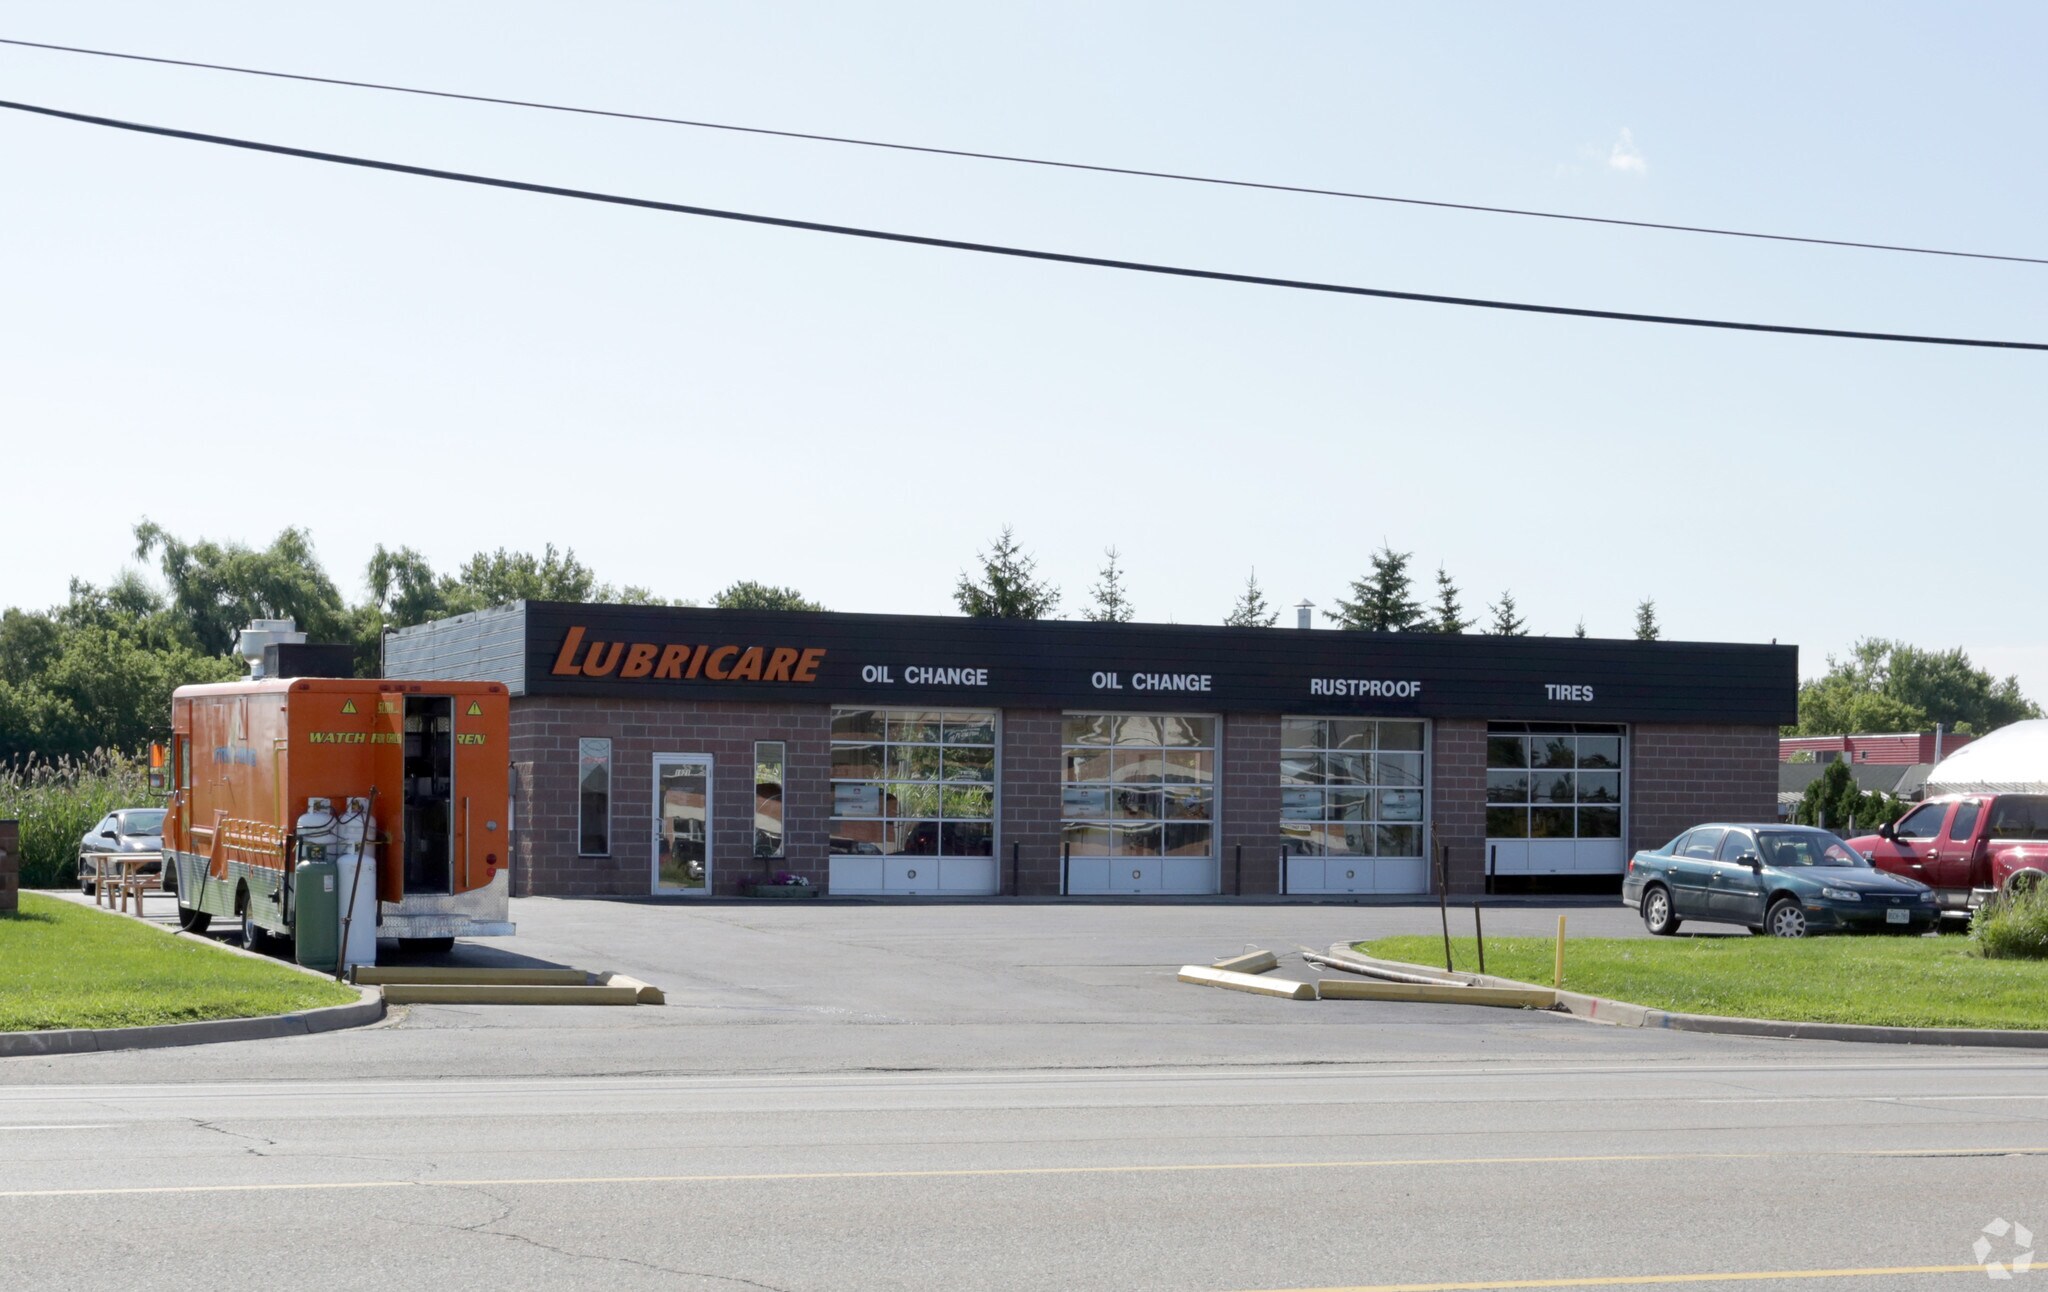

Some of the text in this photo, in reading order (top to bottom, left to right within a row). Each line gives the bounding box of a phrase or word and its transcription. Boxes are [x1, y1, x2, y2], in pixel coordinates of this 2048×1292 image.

[552, 626, 827, 683] LUBRICARE
[861, 664, 989, 686] OIL CHANGE
[1091, 671, 1213, 692] OIL CHANGE
[1310, 678, 1422, 698] RUSTPROOF
[1544, 684, 1595, 702] TIRES
[309, 732, 366, 744] WATCH
